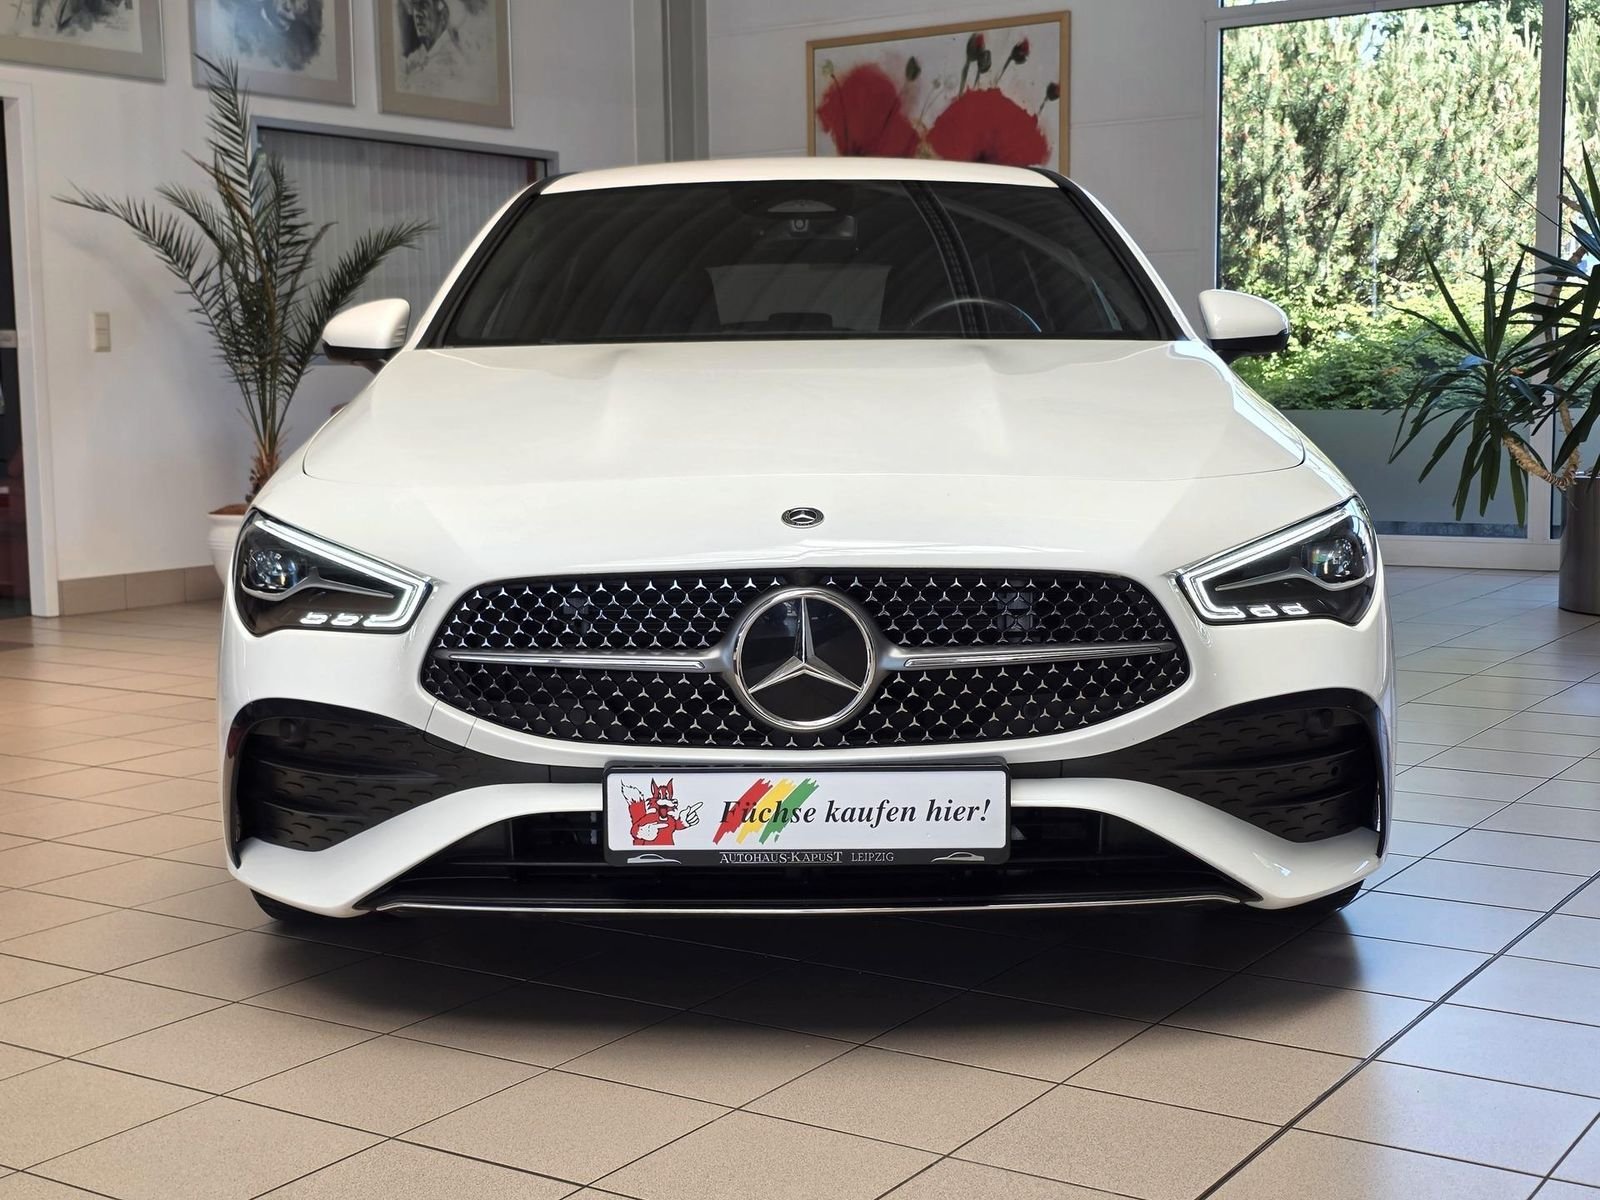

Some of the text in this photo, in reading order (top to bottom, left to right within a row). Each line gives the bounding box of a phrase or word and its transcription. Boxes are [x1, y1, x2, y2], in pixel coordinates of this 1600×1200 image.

[719, 798, 991, 829] Füchse kaufen hier!
[851, 852, 895, 862] LEIPZIG
